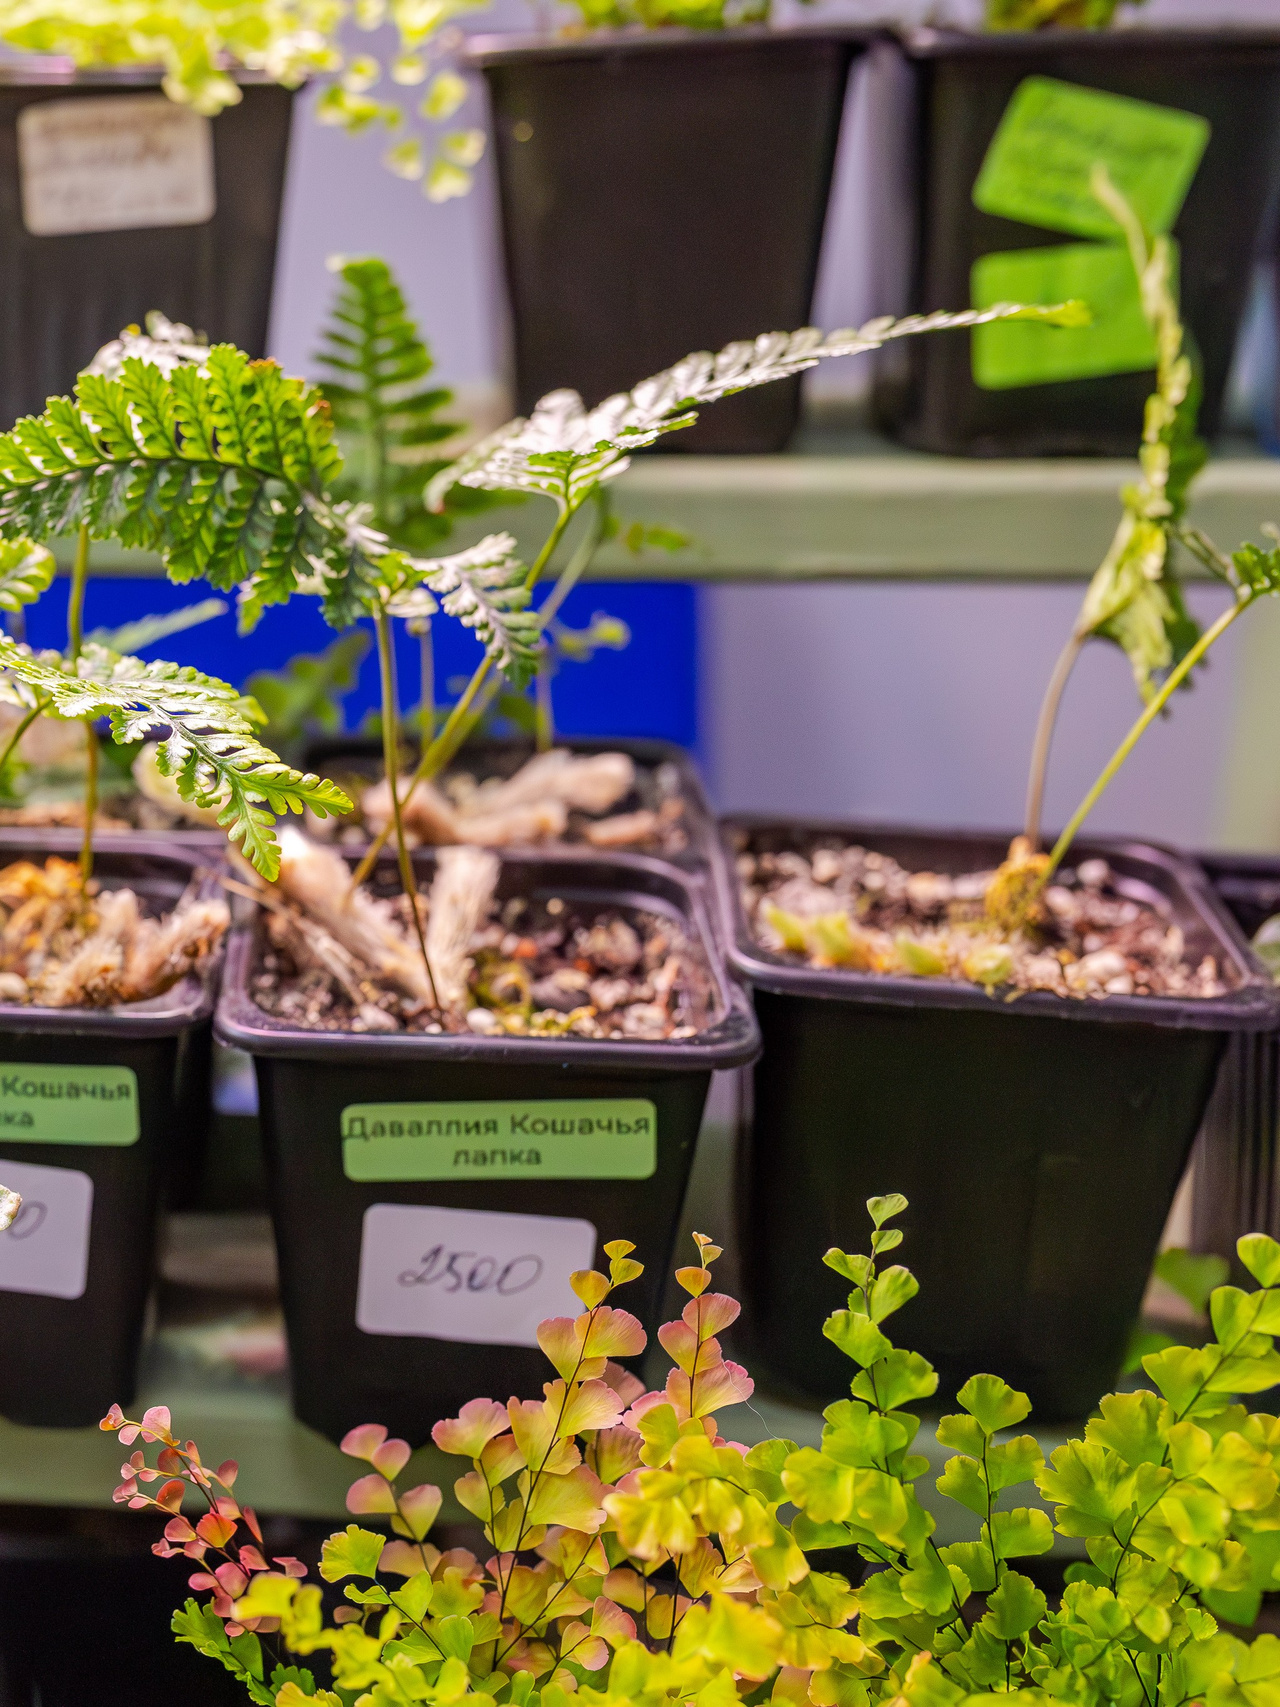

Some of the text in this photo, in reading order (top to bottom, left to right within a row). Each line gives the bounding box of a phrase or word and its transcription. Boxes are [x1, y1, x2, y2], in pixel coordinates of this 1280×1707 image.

[1, 1075, 132, 1102] Кошачья
[343, 1113, 651, 1141] Даваллия Кошачья
[452, 1149, 542, 1167] лапка
[396, 1244, 544, 1297] 2500
